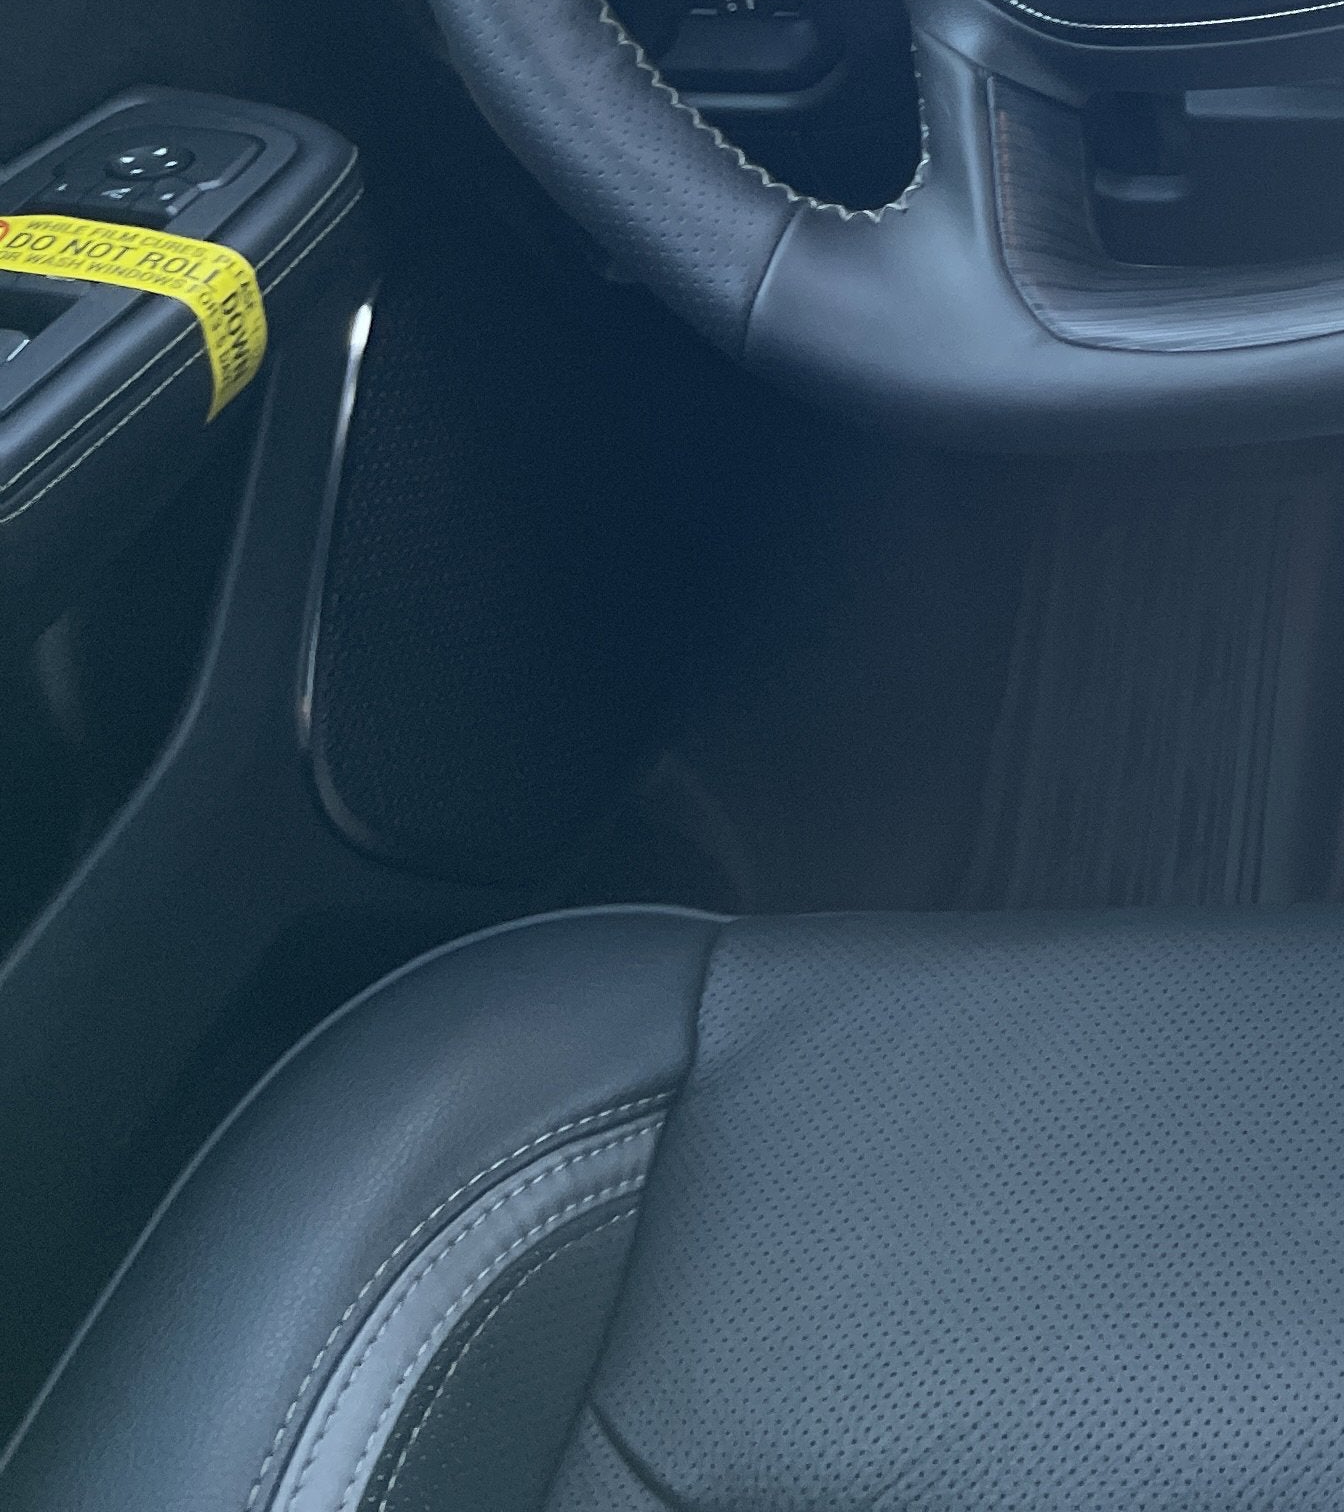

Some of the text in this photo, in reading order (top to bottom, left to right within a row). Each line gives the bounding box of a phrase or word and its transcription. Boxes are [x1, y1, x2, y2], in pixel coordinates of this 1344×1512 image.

[27, 219, 85, 236] WHILE
[91, 226, 138, 243] FILM
[6, 231, 57, 252] DO
[59, 237, 137, 263] NOT
[137, 251, 220, 286] ROLL
[20, 253, 84, 269] WASH
[86, 261, 187, 290] WINDOWS
